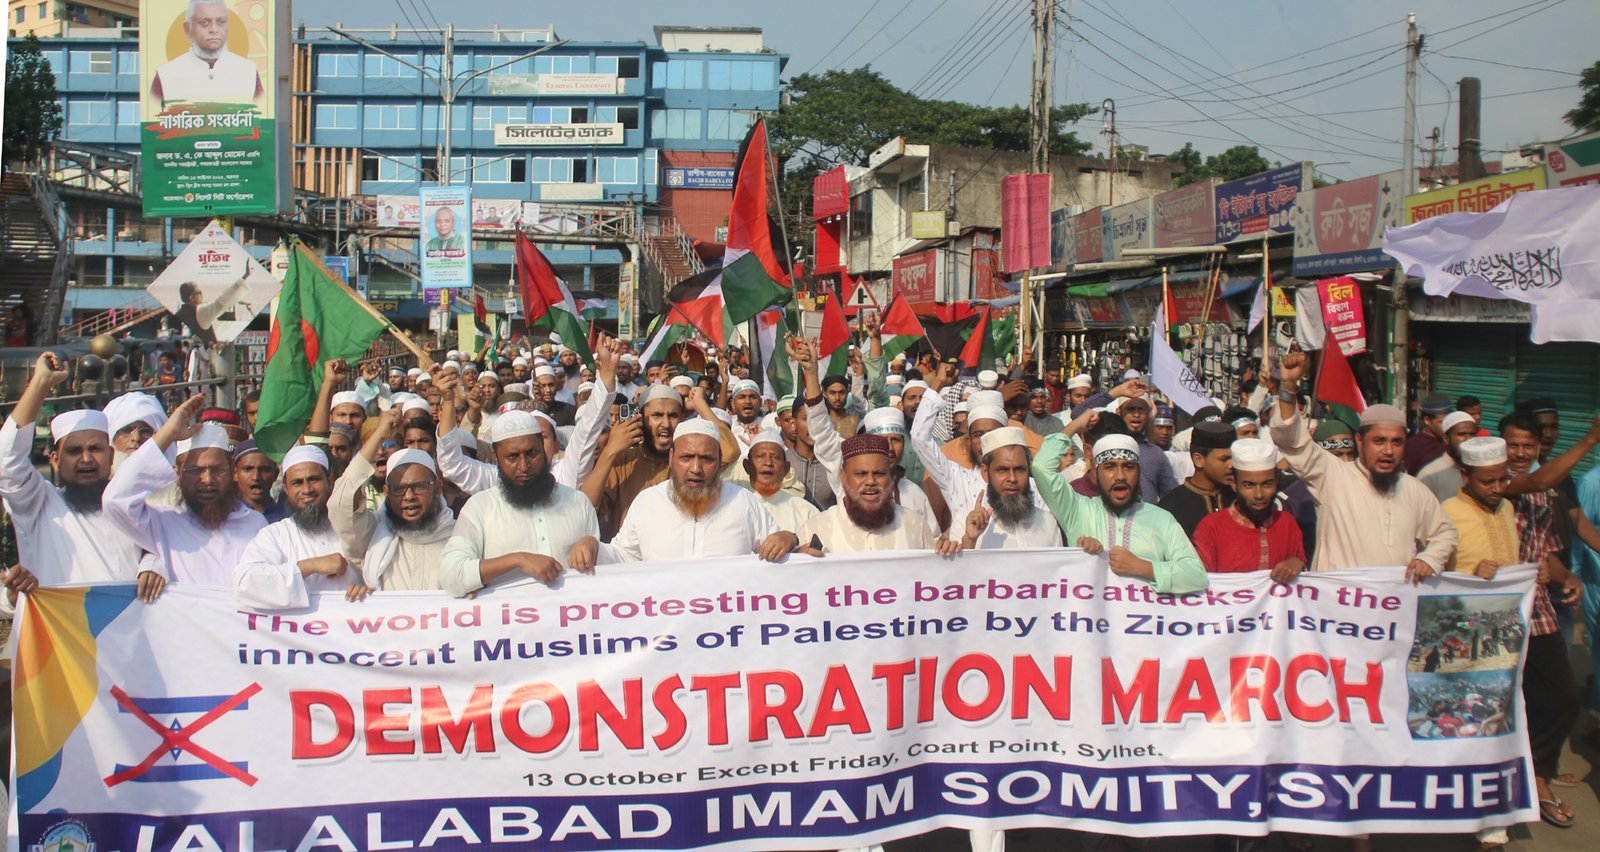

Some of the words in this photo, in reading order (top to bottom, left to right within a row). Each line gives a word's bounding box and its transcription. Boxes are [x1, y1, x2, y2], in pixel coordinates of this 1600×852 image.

[159, 110, 204, 129] নাগরিক
[207, 109, 253, 127] সংবর্ধনা
[505, 126, 575, 139] সিলেটের
[578, 127, 613, 138] ডাক
[1348, 203, 1373, 246] সুজ
[1328, 283, 1354, 303] বিল
[237, 609, 330, 637] The
[349, 604, 482, 634] world
[501, 602, 541, 626] is
[559, 590, 808, 628] protesting
[825, 582, 897, 608] the
[914, 577, 1094, 603] barbaric
[1103, 583, 1255, 608] attacks
[1268, 580, 1319, 601] on
[1336, 584, 1401, 611] the
[238, 643, 456, 668] innocent
[472, 632, 677, 663] Muslims
[697, 626, 743, 649] of
[761, 612, 968, 645] Palestine
[986, 611, 1035, 638] by
[1052, 611, 1110, 634] the
[1124, 611, 1271, 637] Zionist
[1287, 609, 1397, 641] Israel
[290, 654, 1073, 760] DEMONSTRATION
[1101, 655, 1384, 726] MARCH
[522, 772, 554, 787] 13
[563, 767, 688, 787] October
[697, 760, 800, 783] Except
[809, 752, 900, 773] Friday,
[907, 740, 982, 759] Coart
[990, 739, 1067, 757] Point,
[1077, 742, 1164, 762] Sylhet.
[108, 803, 673, 852] JALALABAD
[706, 774, 914, 834] IMAM
[940, 769, 1262, 819] SOMITY,
[1276, 766, 1517, 809] SYLHET
